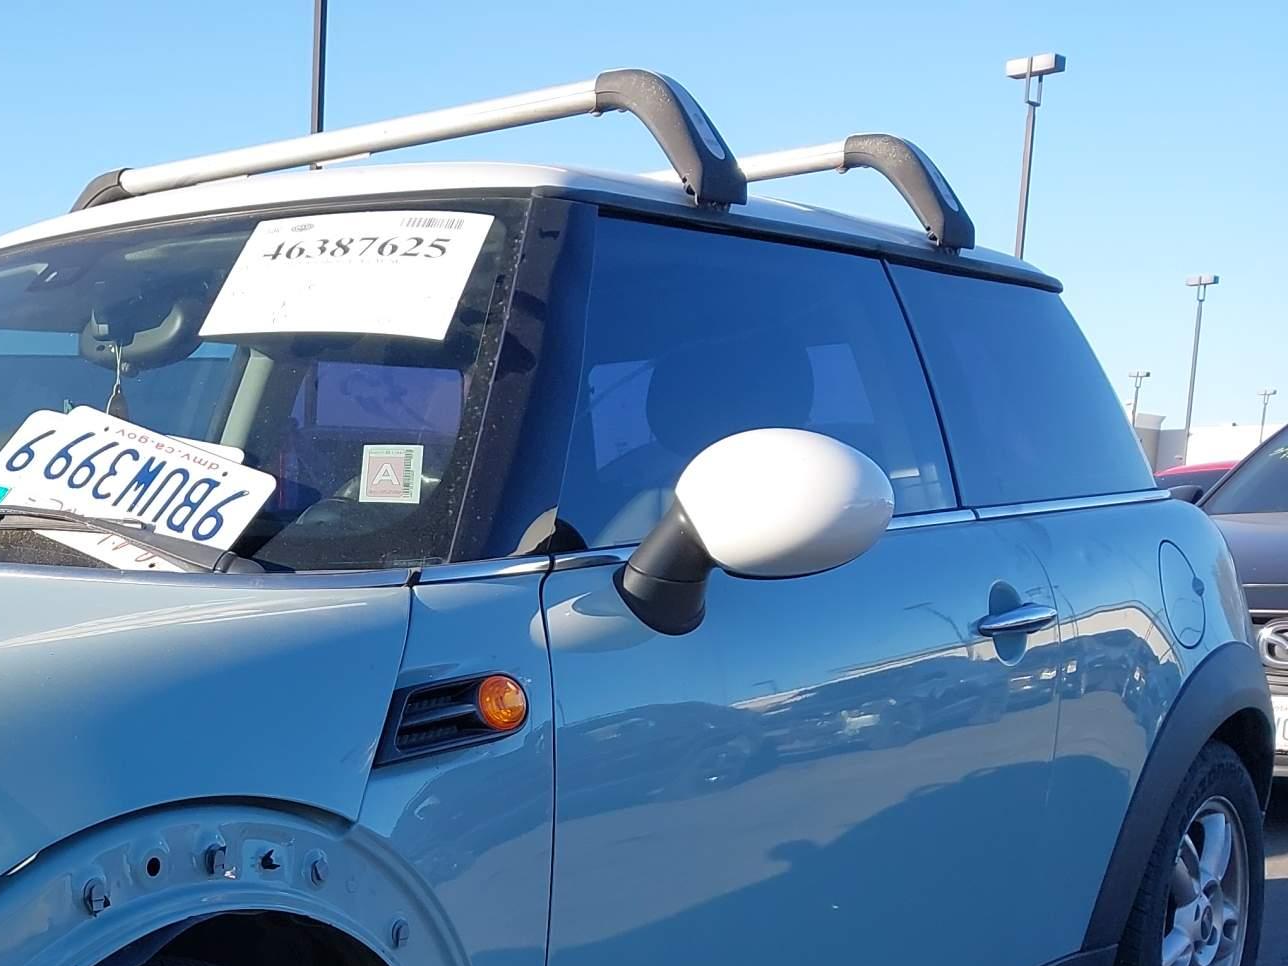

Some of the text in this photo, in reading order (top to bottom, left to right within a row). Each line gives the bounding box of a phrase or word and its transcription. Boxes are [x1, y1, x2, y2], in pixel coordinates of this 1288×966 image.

[263, 236, 452, 261] 46387625
[115, 428, 221, 472] dmv.ca.gov
[43, 432, 250, 541] 9BUW399
[372, 462, 400, 486] A
